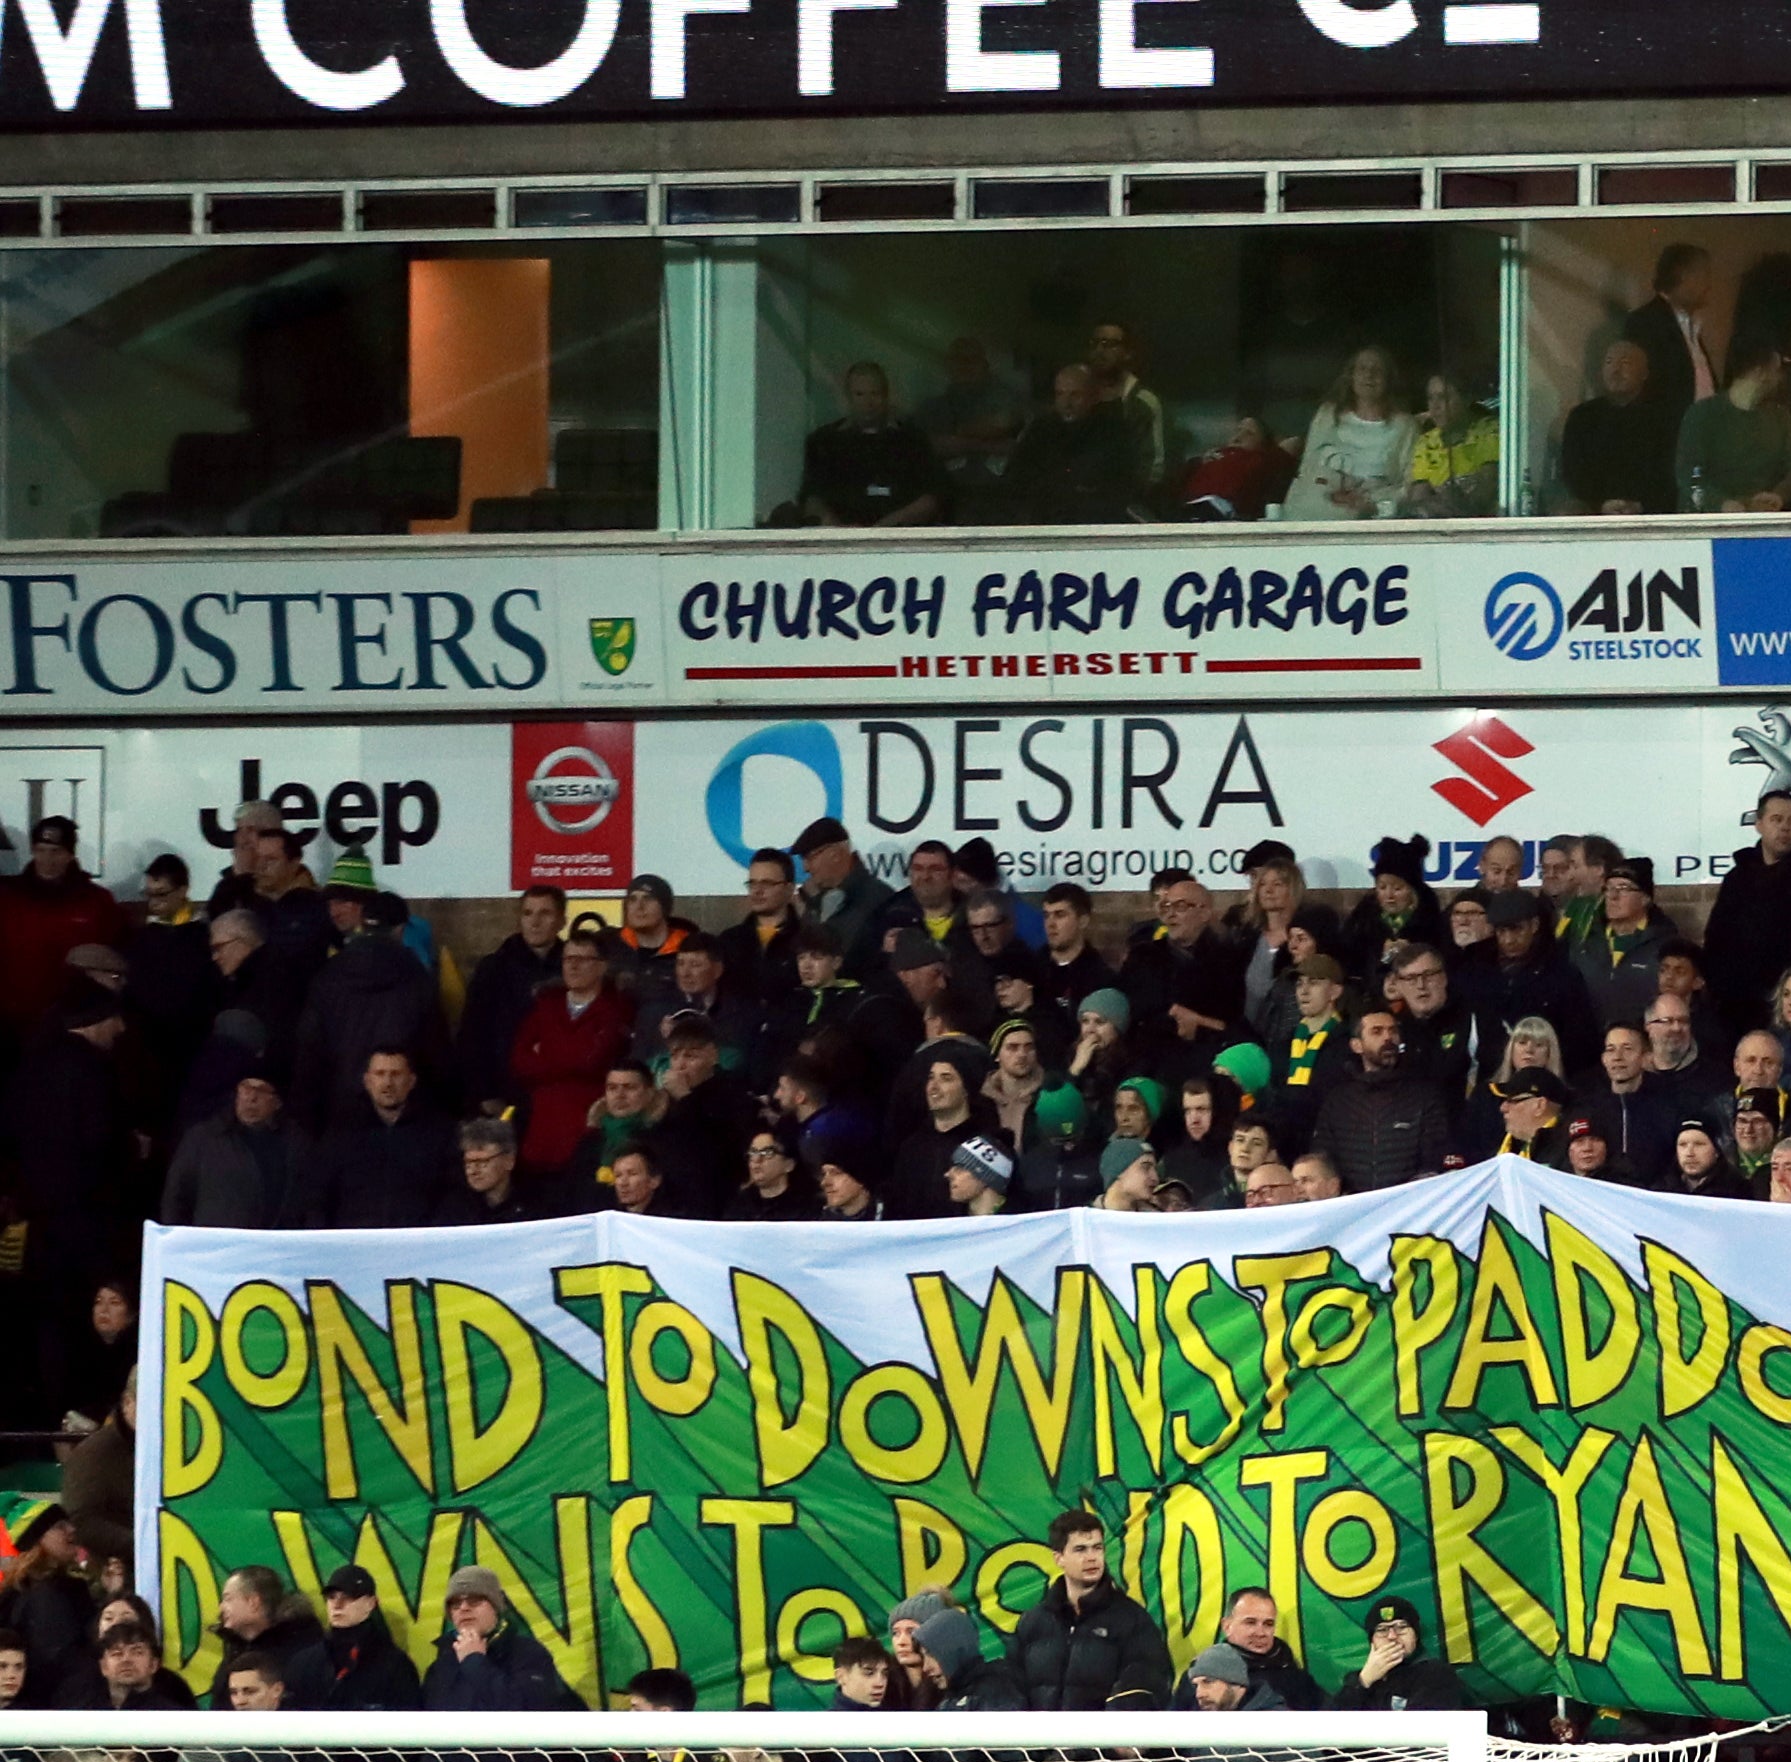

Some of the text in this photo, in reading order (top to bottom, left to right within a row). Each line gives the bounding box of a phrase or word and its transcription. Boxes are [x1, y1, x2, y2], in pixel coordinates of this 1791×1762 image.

[0, 574, 548, 696] FOSTERS
[678, 563, 1410, 642] CHURCH FARM GARAGE
[1566, 566, 1702, 633] AJN
[902, 650, 1199, 678] HETHERSETT
[1569, 637, 1702, 661] STEELSTOCK
[200, 758, 440, 865] Jeep
[534, 781, 610, 798] NISSAN
[859, 714, 1285, 833] DESIRA
[534, 852, 610, 865] Innovation
[161, 1276, 546, 1500] BOND
[158, 1492, 677, 1710] DWNS
